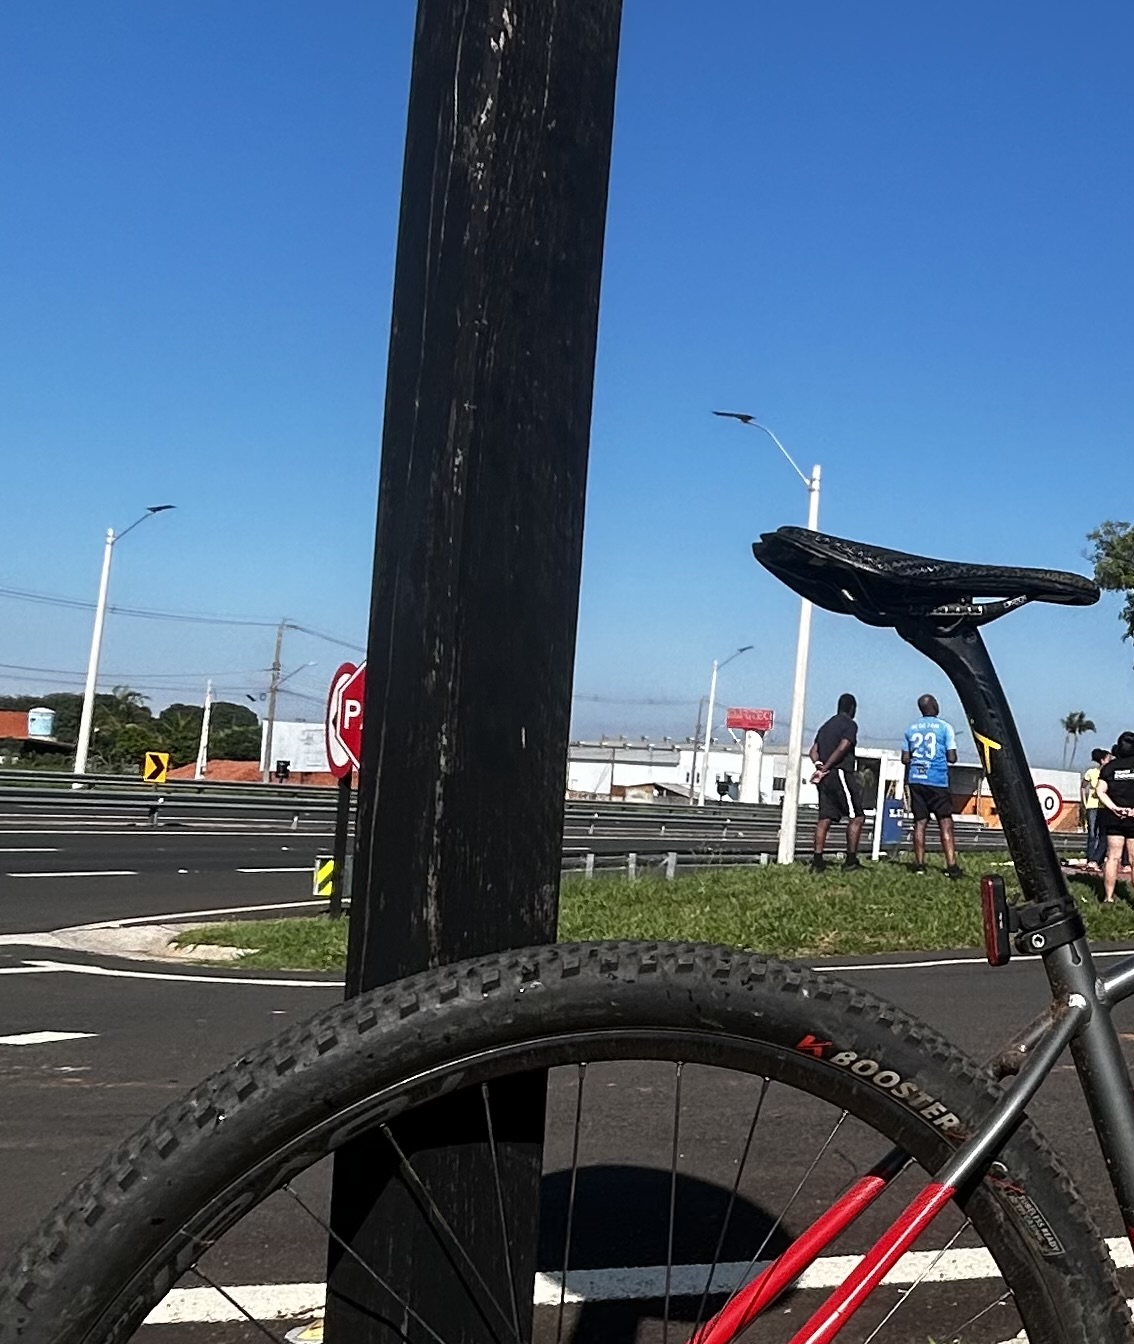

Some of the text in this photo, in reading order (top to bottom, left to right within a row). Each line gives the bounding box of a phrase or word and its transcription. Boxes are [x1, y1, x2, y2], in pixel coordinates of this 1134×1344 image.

[343, 699, 363, 729] P
[910, 732, 937, 760] 23
[829, 1051, 961, 1131] BOOSTER
